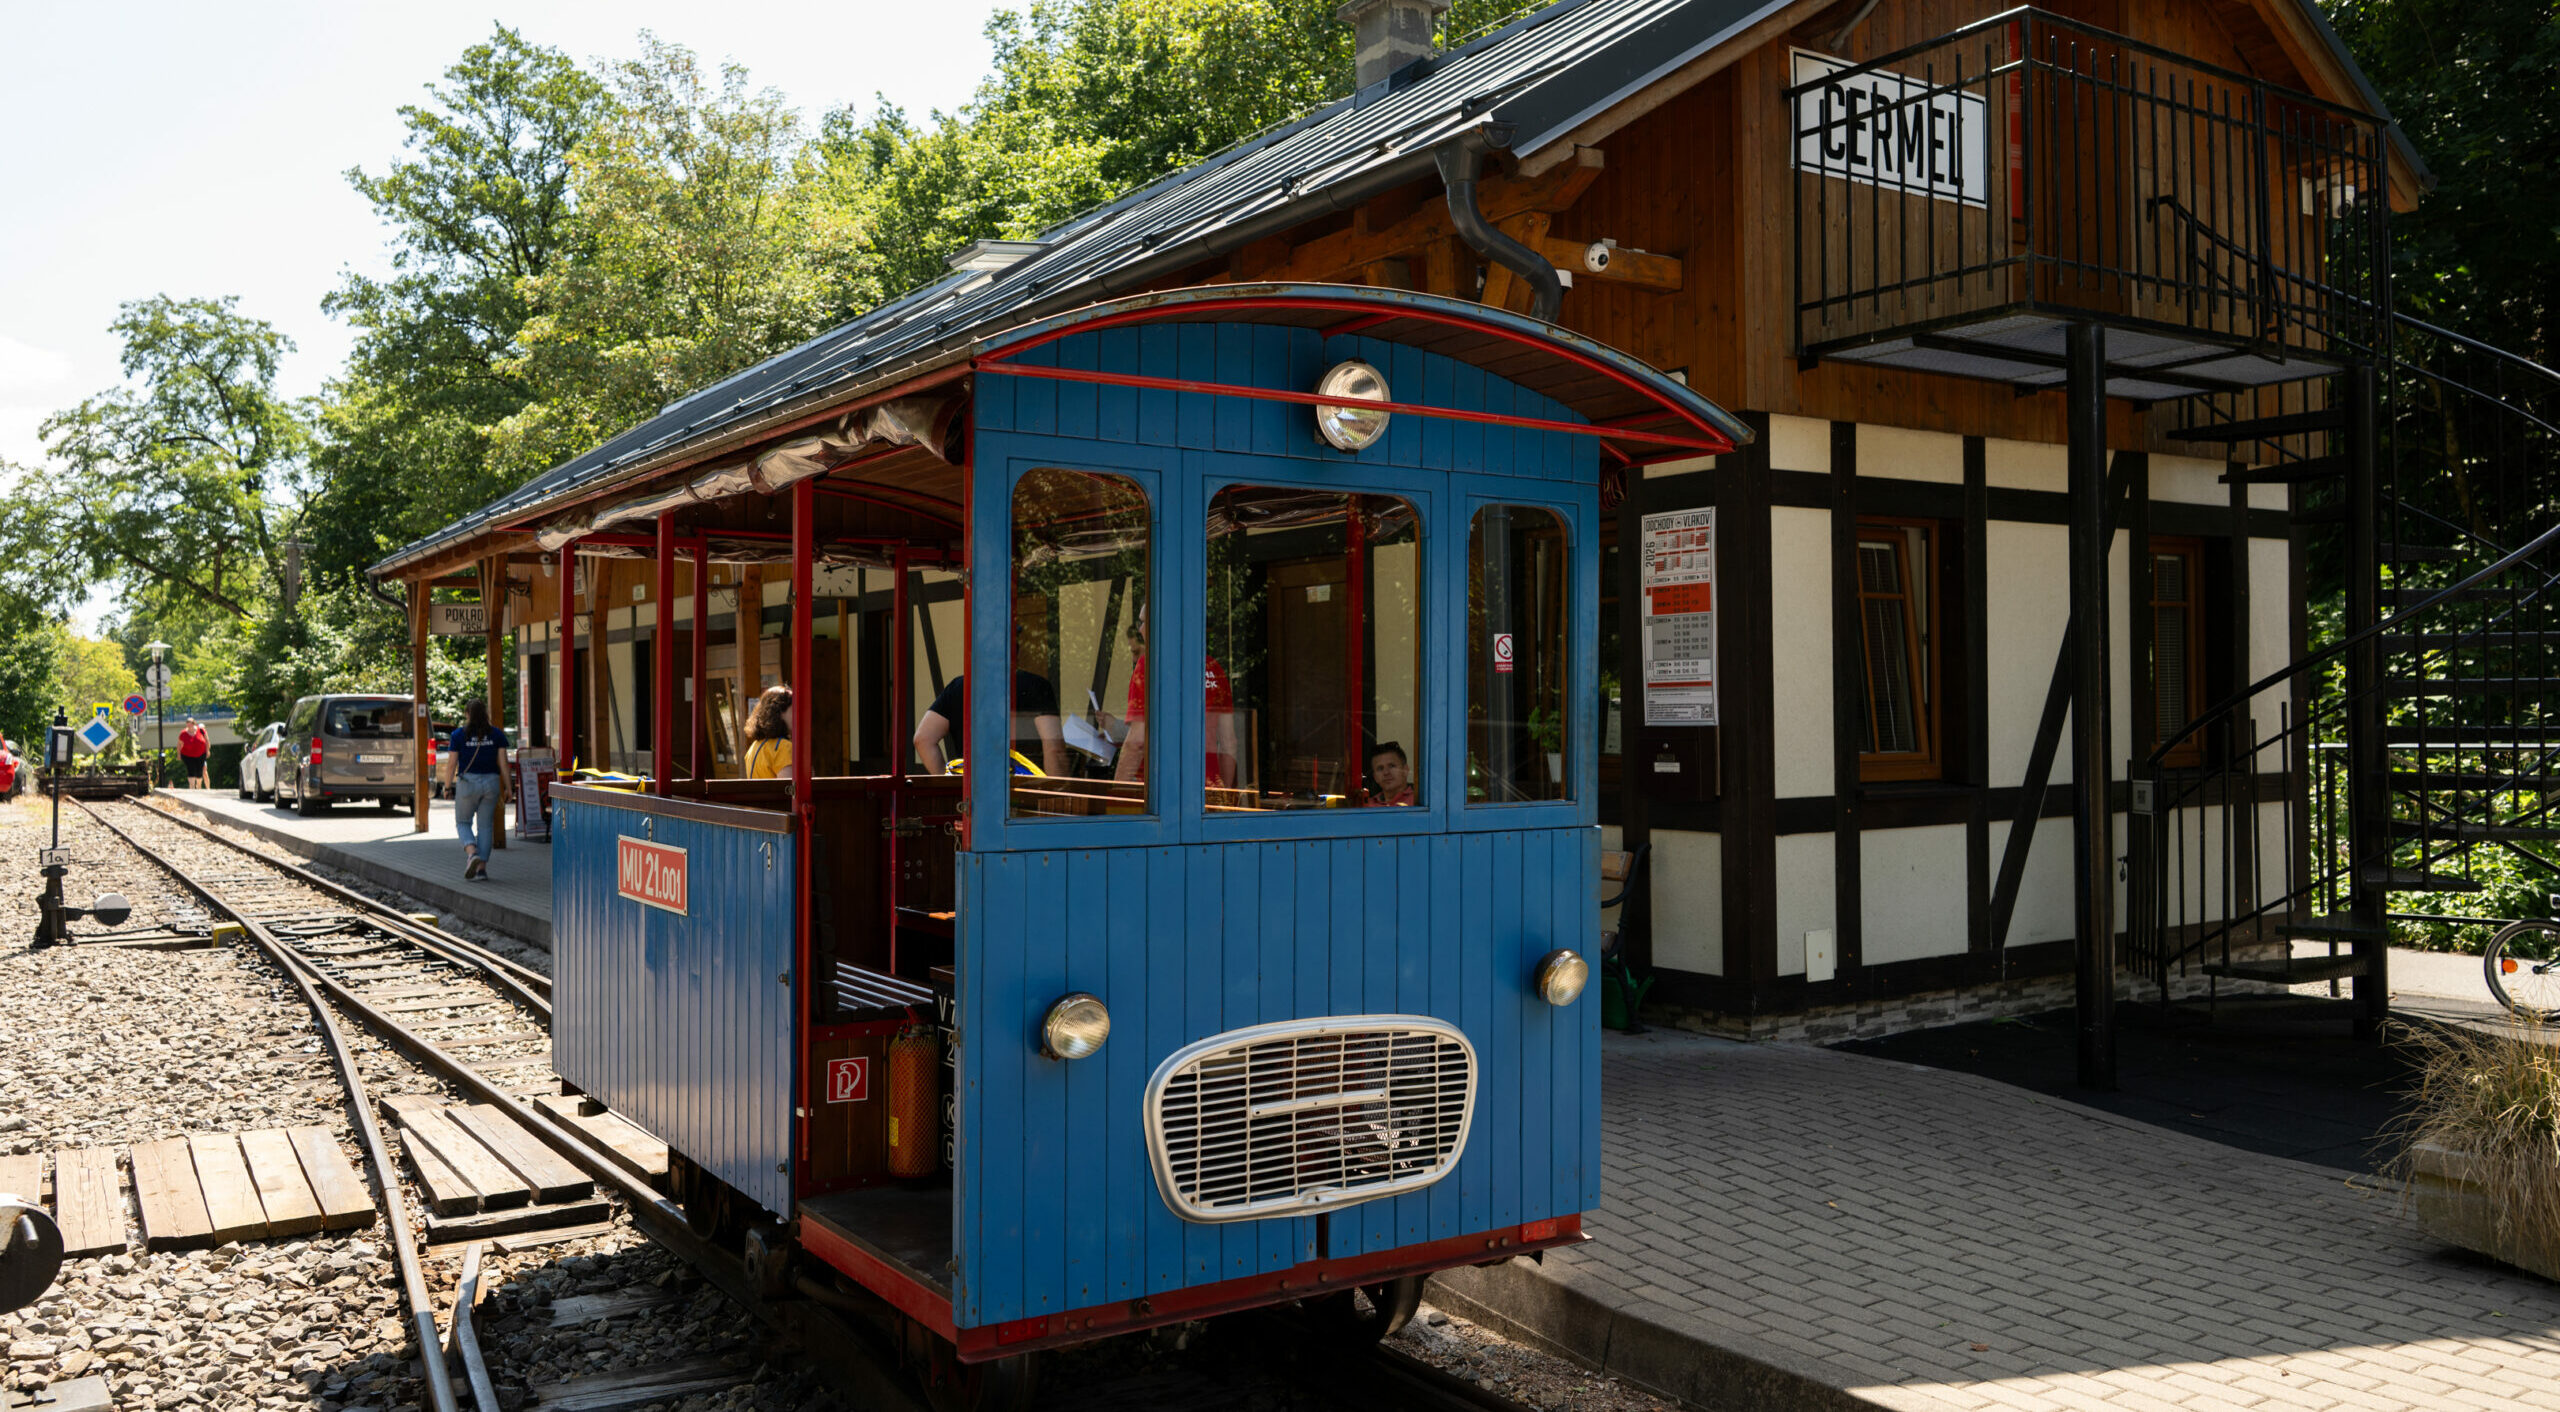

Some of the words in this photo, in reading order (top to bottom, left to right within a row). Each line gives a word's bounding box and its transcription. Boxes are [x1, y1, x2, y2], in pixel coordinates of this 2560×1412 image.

[1683, 513, 1711, 527] VLAKOV
[1645, 541, 1656, 567] 2026
[445, 608, 484, 622] POKLAD
[47, 851, 64, 863] 1a
[622, 846, 643, 892] MU
[645, 852, 681, 905] 21.001
